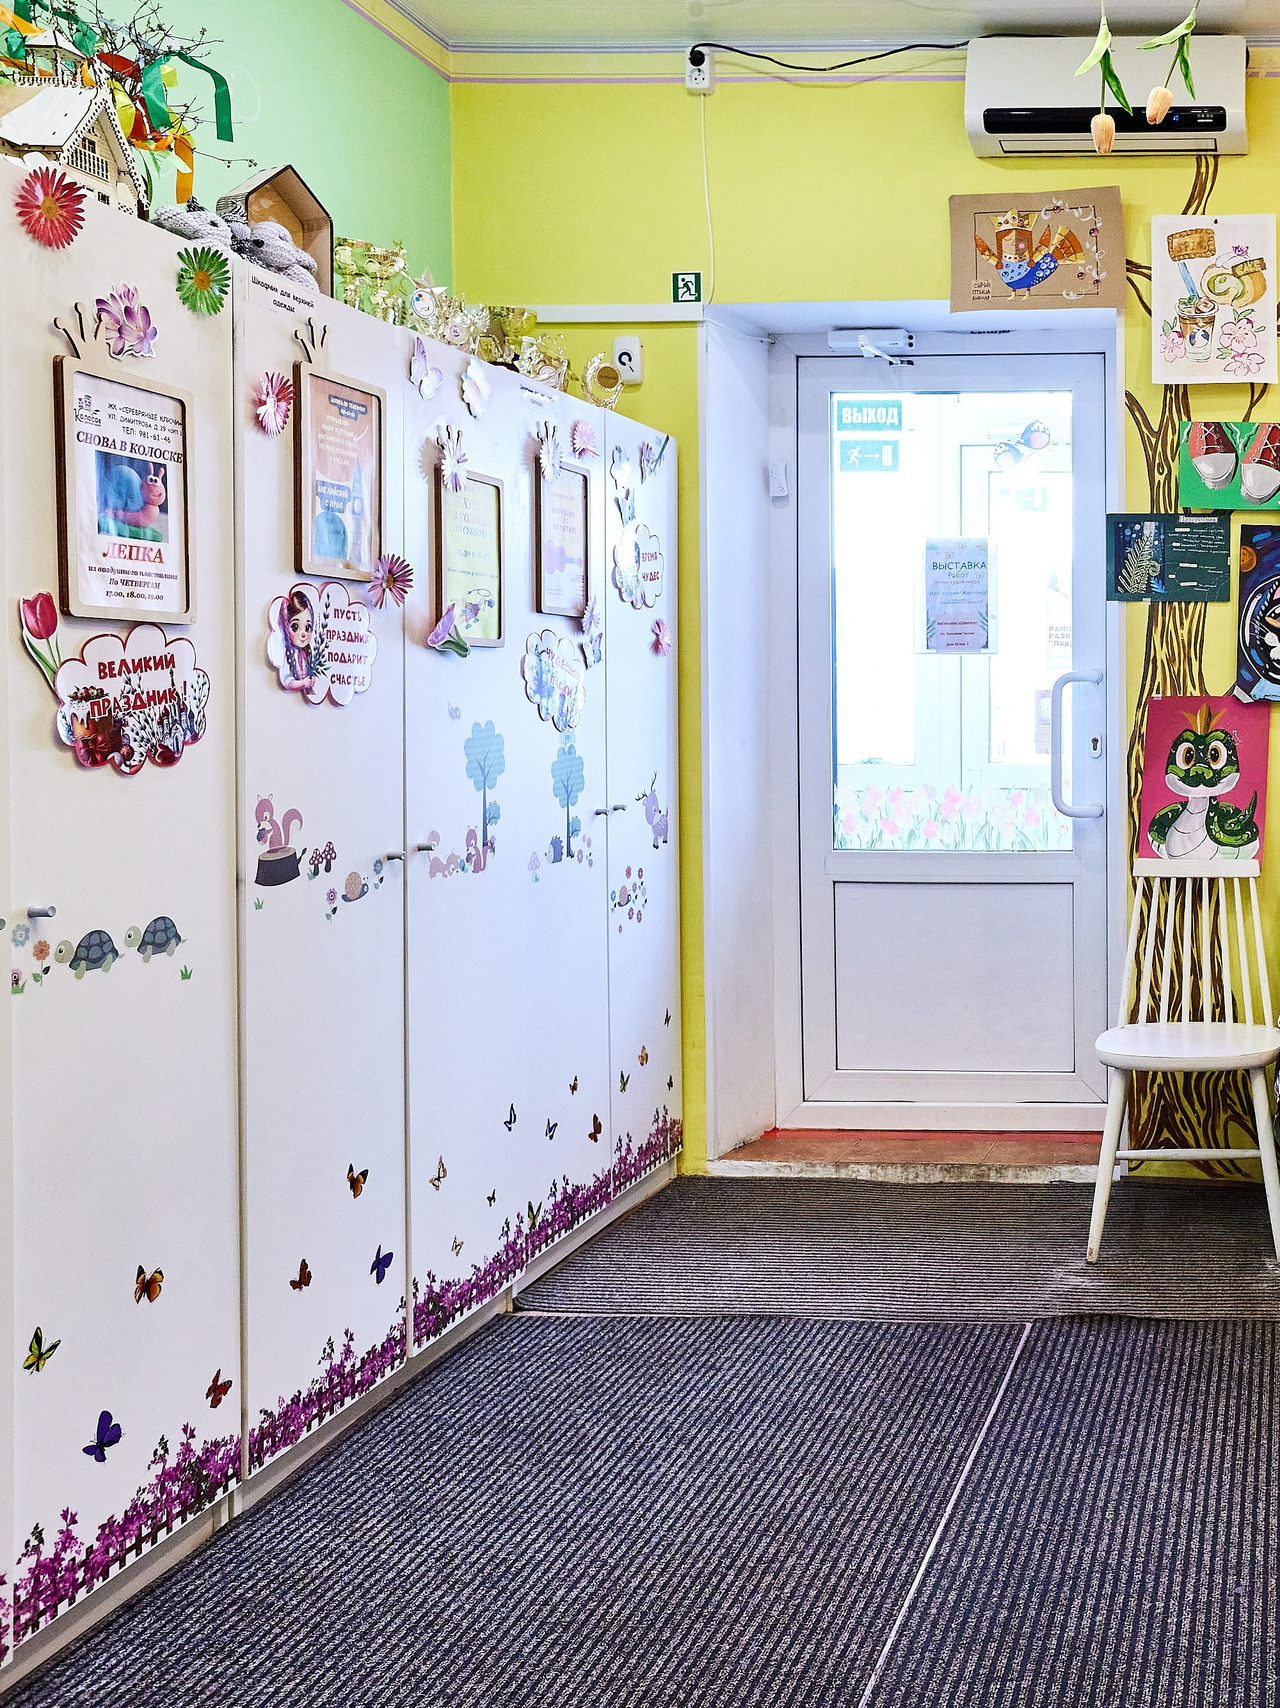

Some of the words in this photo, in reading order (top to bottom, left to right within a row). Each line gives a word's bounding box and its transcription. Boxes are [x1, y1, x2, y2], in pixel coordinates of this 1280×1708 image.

[1236, 260, 1261, 276] CAKE
[108, 402, 117, 411] ЖК
[842, 406, 899, 426] ВЫХОД
[122, 426, 137, 436] ТЕЛ:
[138, 430, 172, 444] 981-61-46
[76, 430, 118, 450] СНОВА
[120, 441, 127, 452] В
[129, 442, 183, 464] КОЛОСКЕ
[102, 542, 164, 564] ЛЕПКА
[642, 552, 658, 562] ВРЕМЯ
[932, 561, 987, 571] ВЫСТАВКА
[642, 571, 660, 582] ЧУДЕС
[108, 578, 118, 586] По
[120, 580, 161, 590] ЧЕТВЕРГАМ
[106, 590, 125, 598] 17.00,
[126, 592, 148, 600] 18.00,
[334, 608, 362, 622] ПУСТЬ
[326, 629, 369, 644] ПРАЗДНИК
[327, 652, 368, 665] ПОДАРИТ
[98, 652, 176, 681] ВЕЛИКИЙ
[330, 674, 366, 687] СЧАСТЬЕ
